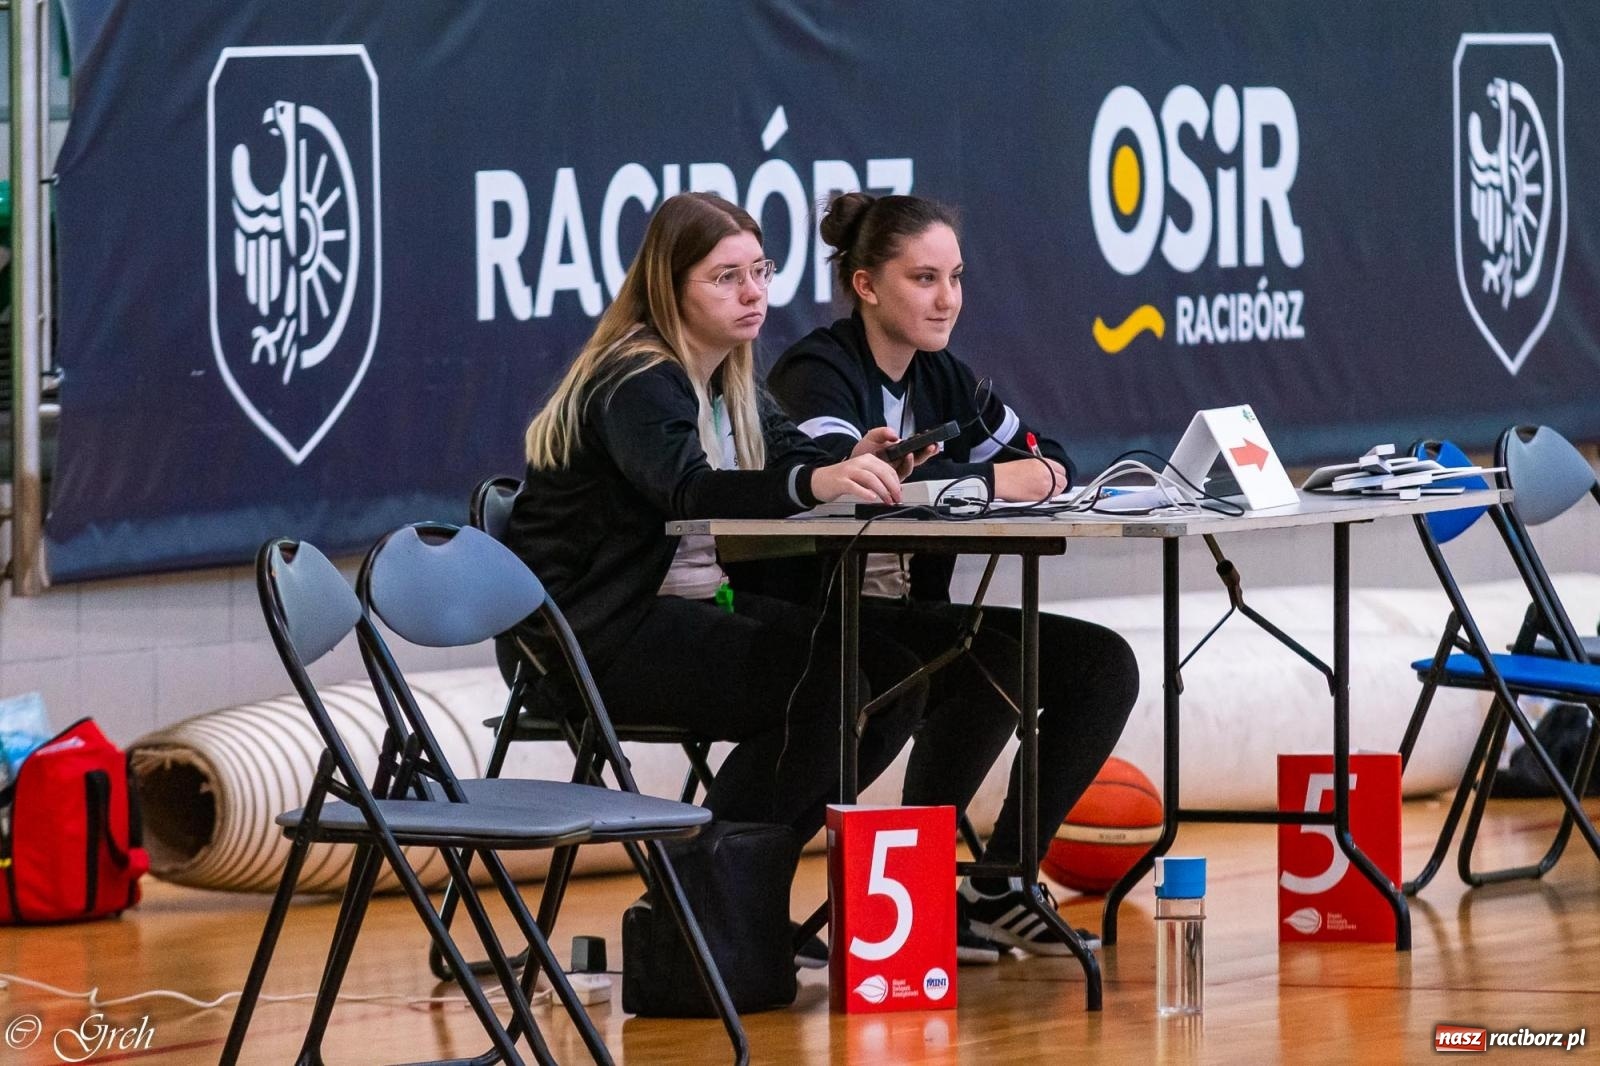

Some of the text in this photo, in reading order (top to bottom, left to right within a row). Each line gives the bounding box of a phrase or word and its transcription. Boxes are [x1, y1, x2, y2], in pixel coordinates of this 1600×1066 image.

[475, 105, 913, 321] RACÓR
[1176, 276, 1305, 345] RACIBÓRZ
[849, 829, 919, 961] 5
[1280, 773, 1358, 895] 5
